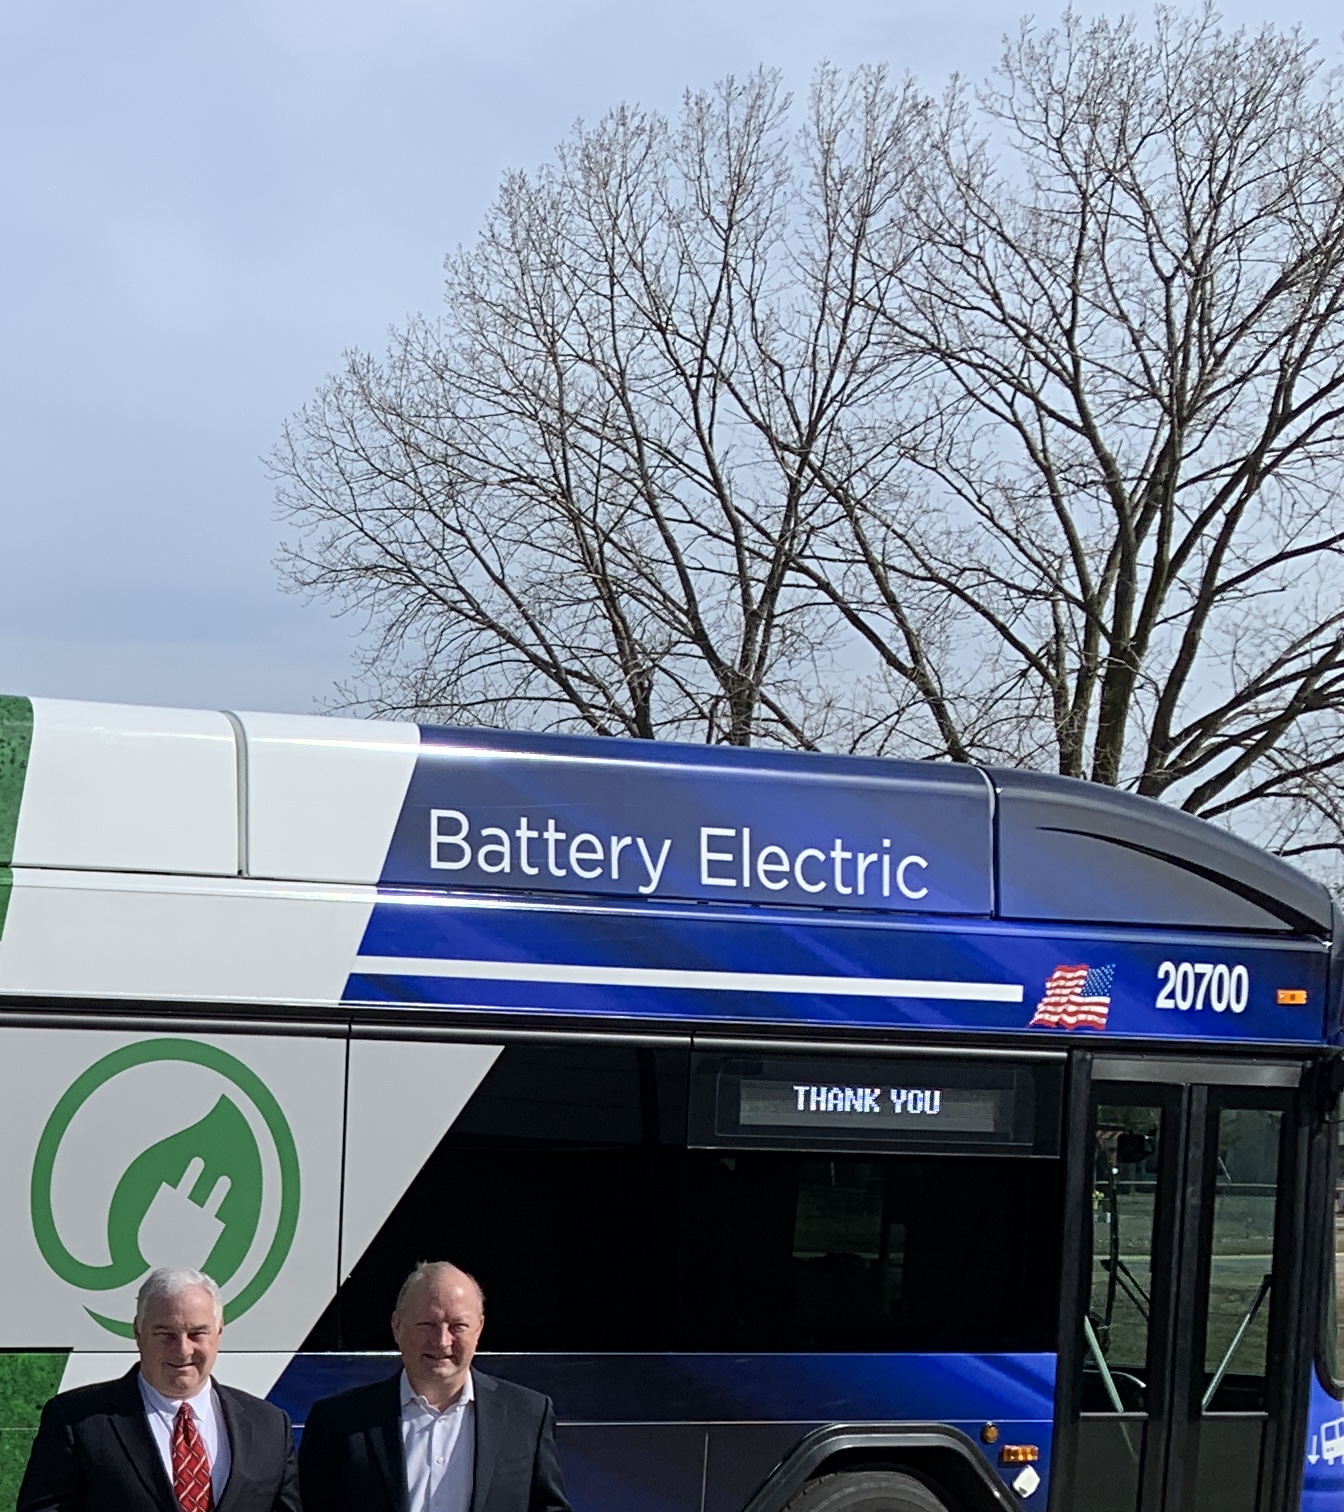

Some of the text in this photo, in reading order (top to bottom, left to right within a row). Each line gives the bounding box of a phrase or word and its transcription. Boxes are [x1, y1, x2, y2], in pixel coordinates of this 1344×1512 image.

[429, 808, 929, 899] Battery Electric
[1155, 961, 1249, 1014] 20700
[792, 1085, 942, 1115] THANK YOU
